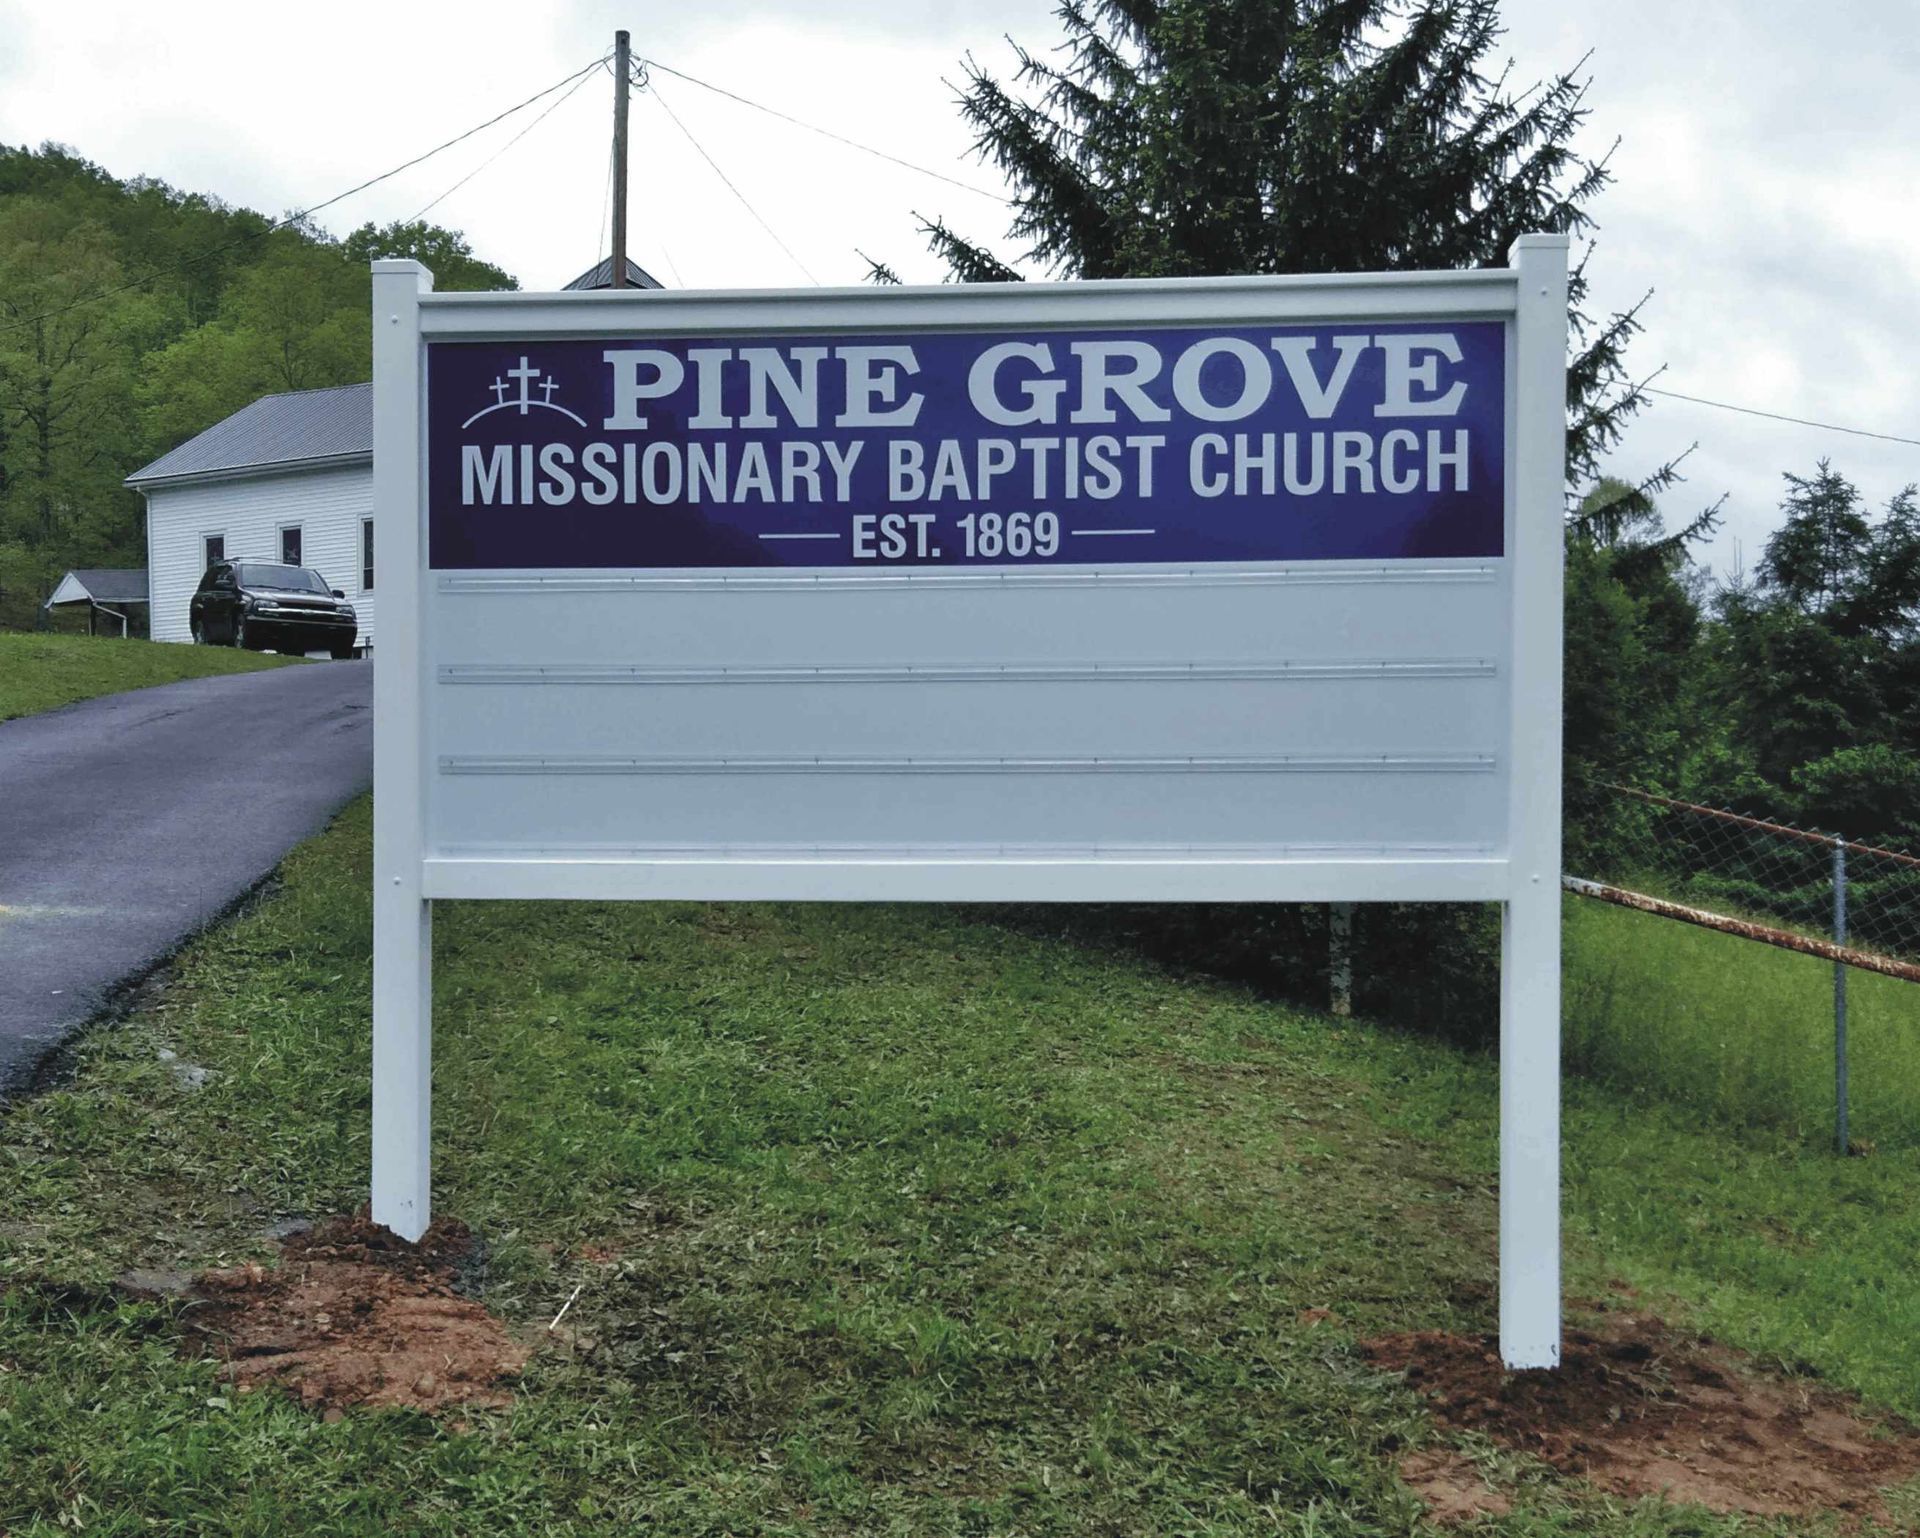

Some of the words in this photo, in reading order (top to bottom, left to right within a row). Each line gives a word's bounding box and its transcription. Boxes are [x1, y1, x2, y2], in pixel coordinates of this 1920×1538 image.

[603, 345, 925, 430] PINE
[967, 333, 1468, 427] GROVE
[461, 440, 865, 505] MISSIONARY
[888, 435, 1166, 502] BAPTIST
[1189, 429, 1470, 497] CHURCH
[852, 513, 941, 559] EST.
[956, 511, 1060, 558] 1869
